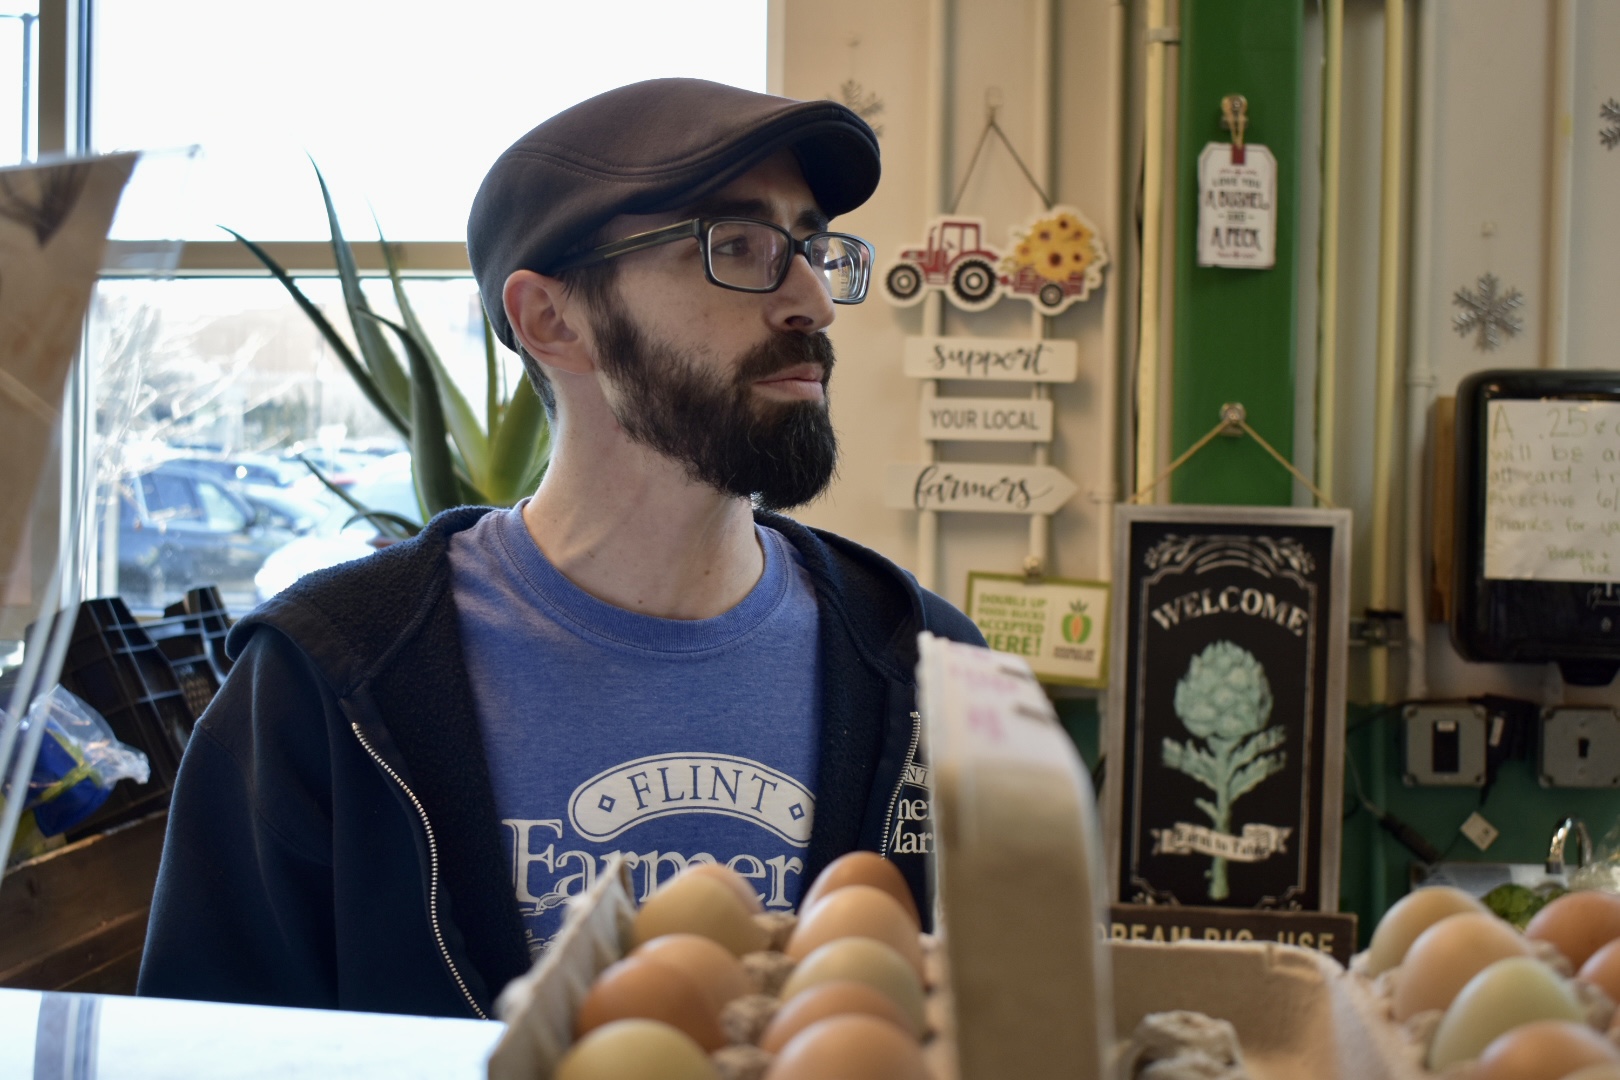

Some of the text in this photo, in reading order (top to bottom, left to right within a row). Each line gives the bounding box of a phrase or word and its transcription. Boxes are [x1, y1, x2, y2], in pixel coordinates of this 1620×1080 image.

[1210, 227, 1262, 252] A PECK
[930, 410, 1040, 430] YOUR LOCAL
[913, 464, 1054, 511] farmers
[1151, 585, 1308, 637] WELCOME
[626, 765, 778, 814] FLINT
